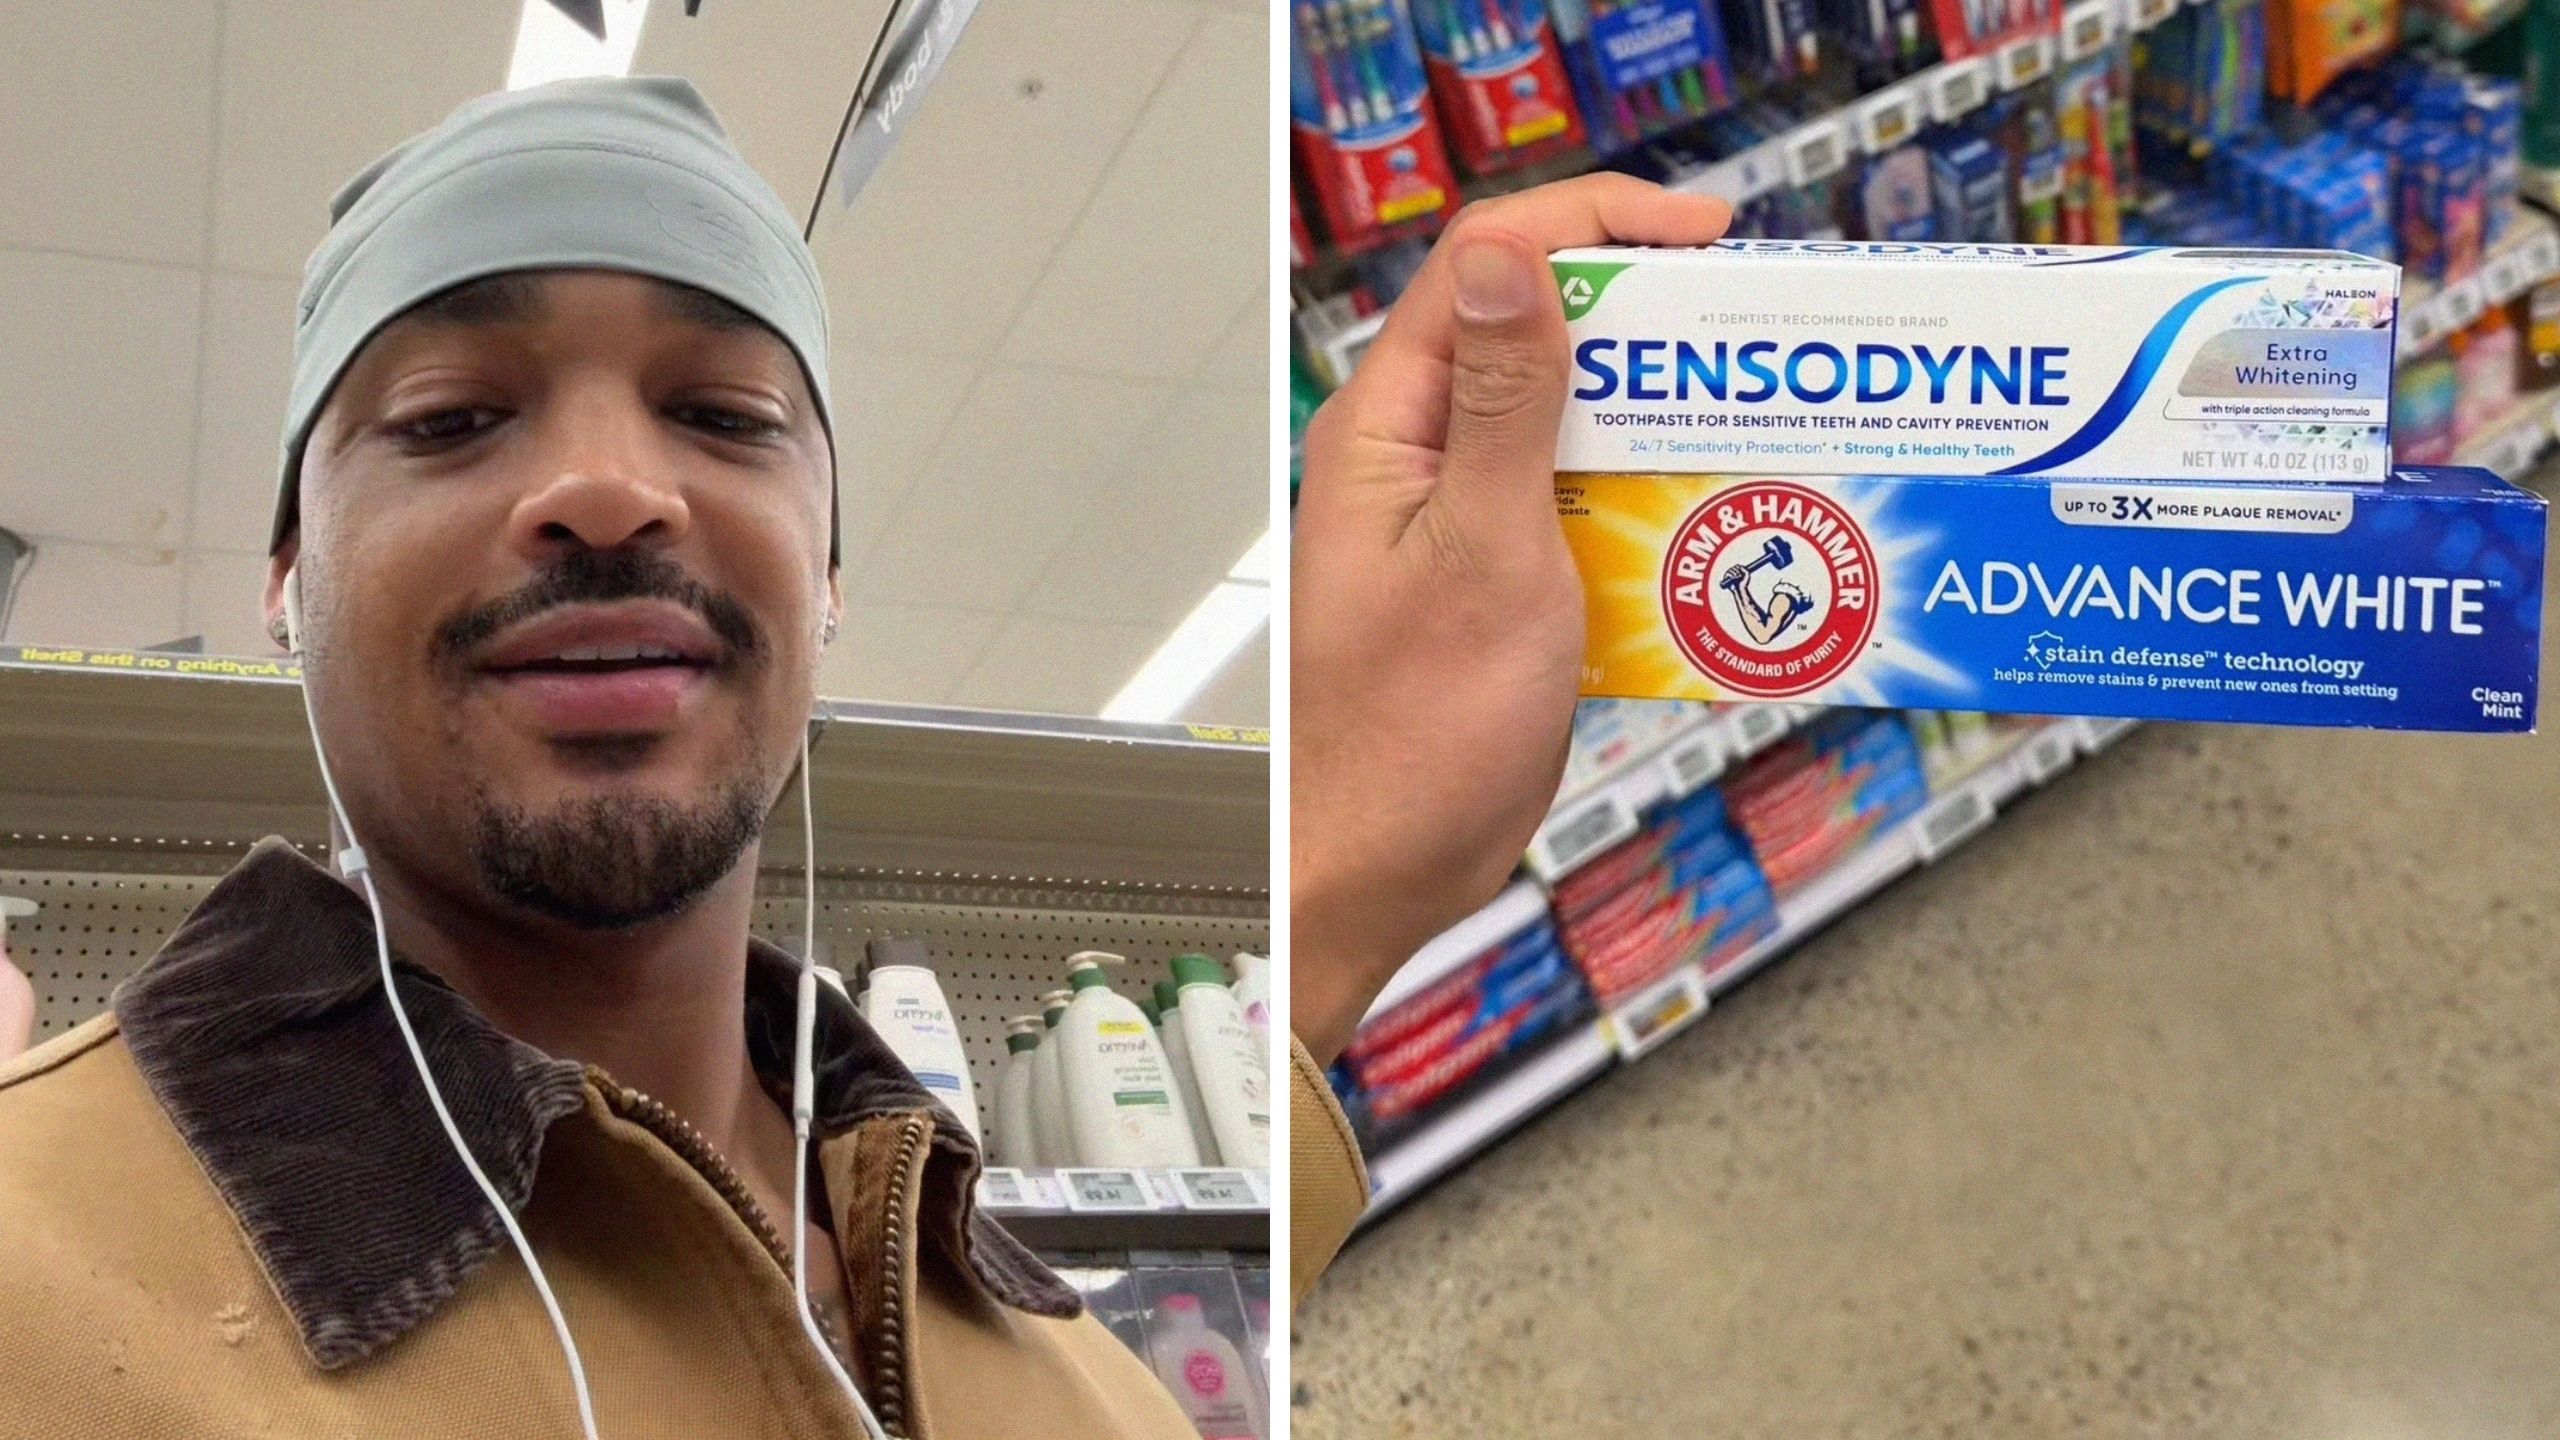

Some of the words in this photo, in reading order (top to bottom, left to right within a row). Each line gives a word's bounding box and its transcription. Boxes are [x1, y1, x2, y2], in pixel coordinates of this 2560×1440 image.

[2325, 289, 2376, 299] HALEON
[1700, 313, 1715, 324] #1
[1719, 313, 1777, 325] DENTIST
[1783, 314, 1895, 327] RECOMMENDED
[1900, 316, 1948, 328] BRAND
[2266, 343, 2328, 361] Extra
[1573, 337, 2070, 406] SENSODYNE
[2235, 366, 2358, 391] Whitening
[1594, 413, 1693, 427] TOOTHPASTE
[1698, 414, 1728, 427] FOR
[1732, 415, 1807, 428] SENSITIVE
[1812, 416, 1856, 428] TEETH
[1860, 417, 1893, 429] AND
[1897, 417, 1951, 430] CAVITY
[1956, 418, 2049, 431] PREVENTION
[2201, 404, 2224, 414] with
[2224, 405, 2251, 418] triple
[2252, 405, 2284, 415] action
[2286, 406, 2330, 418] cleaning
[2331, 406, 2370, 417] formula
[1629, 439, 1664, 452] 24/7
[1667, 439, 1742, 456] Sensitivity
[1844, 442, 1894, 458] Strong
[1898, 443, 1908, 455] &
[1912, 443, 1970, 458] Healthy
[1974, 444, 2015, 457] Teeth
[2182, 451, 2214, 468] NET
[2221, 451, 2248, 468] WT
[2253, 452, 2280, 469] 4.0
[2284, 453, 2307, 470] OZ
[2312, 453, 2348, 472] (113
[2352, 455, 2369, 473] g)
[2064, 501, 2083, 512] UP
[2089, 502, 2107, 513] TO
[2111, 496, 2154, 520] 3X
[2156, 504, 2199, 516] MORE
[2203, 506, 2261, 519] PLAQUE
[1675, 524, 1723, 607] ARM
[1717, 503, 1749, 534] &
[1752, 494, 1867, 611] HAMMER
[1923, 559, 2262, 624] ADVANCE
[1695, 625, 1718, 652] THE
[1715, 646, 1783, 677] STANDARD
[1785, 660, 1803, 675] OF
[1802, 630, 1843, 669] PURITY
[2045, 644, 2105, 664] stain
[2224, 651, 2365, 679] technology
[1993, 668, 2034, 683] helps
[2037, 672, 2095, 685] remove
[2098, 673, 2144, 687] stains
[2147, 675, 2158, 687] &
[2161, 676, 2221, 691] prevent
[2225, 680, 2258, 692] new
[2260, 681, 2298, 693] ones
[2300, 680, 2339, 695] from
[2342, 682, 2398, 700] setting
[2471, 687, 2524, 703] Clean
[2481, 703, 2523, 719] Mint
